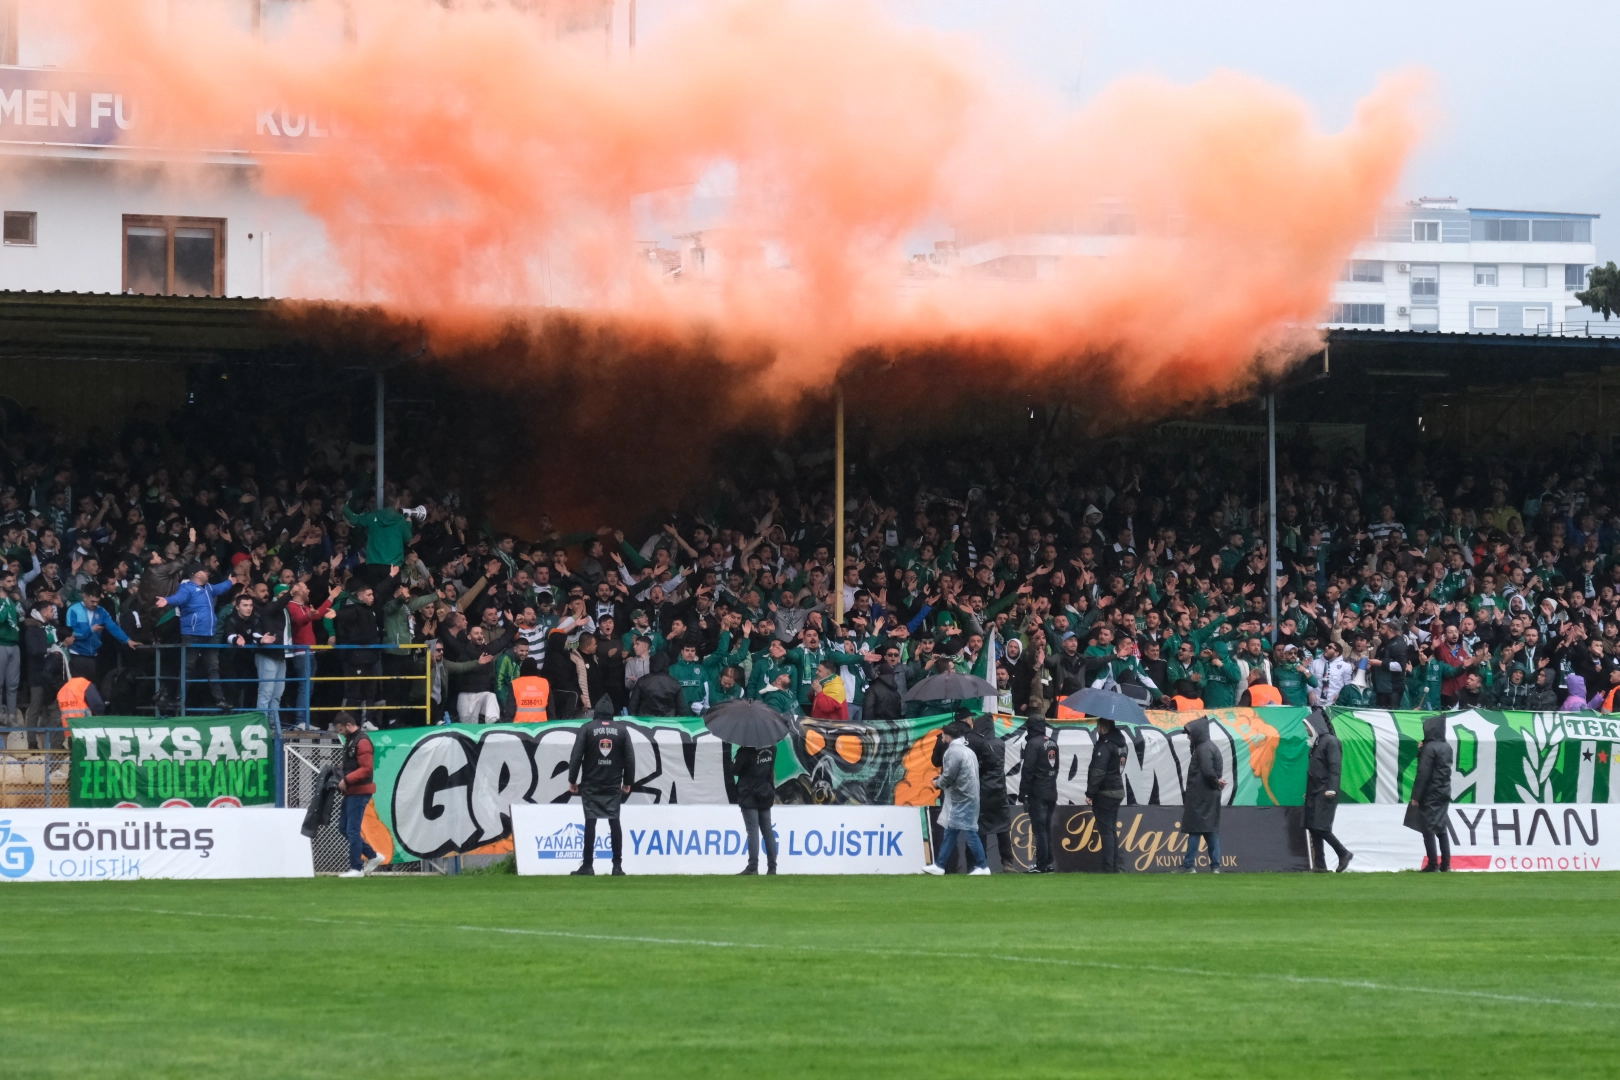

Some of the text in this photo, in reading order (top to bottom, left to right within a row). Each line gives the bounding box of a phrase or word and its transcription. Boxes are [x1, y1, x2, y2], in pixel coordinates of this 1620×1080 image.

[71, 724, 268, 766] TEKSAS
[593, 727, 605, 737] SPOR
[79, 758, 269, 799] ZERO TOLERANCE
[43, 821, 215, 859] Gönültaş
[535, 832, 612, 850] YANARAĞ
[788, 823, 904, 857] LOJİSTİK
[49, 855, 141, 878] LOJİSTİK
[1494, 852, 1601, 870] otomotiv
